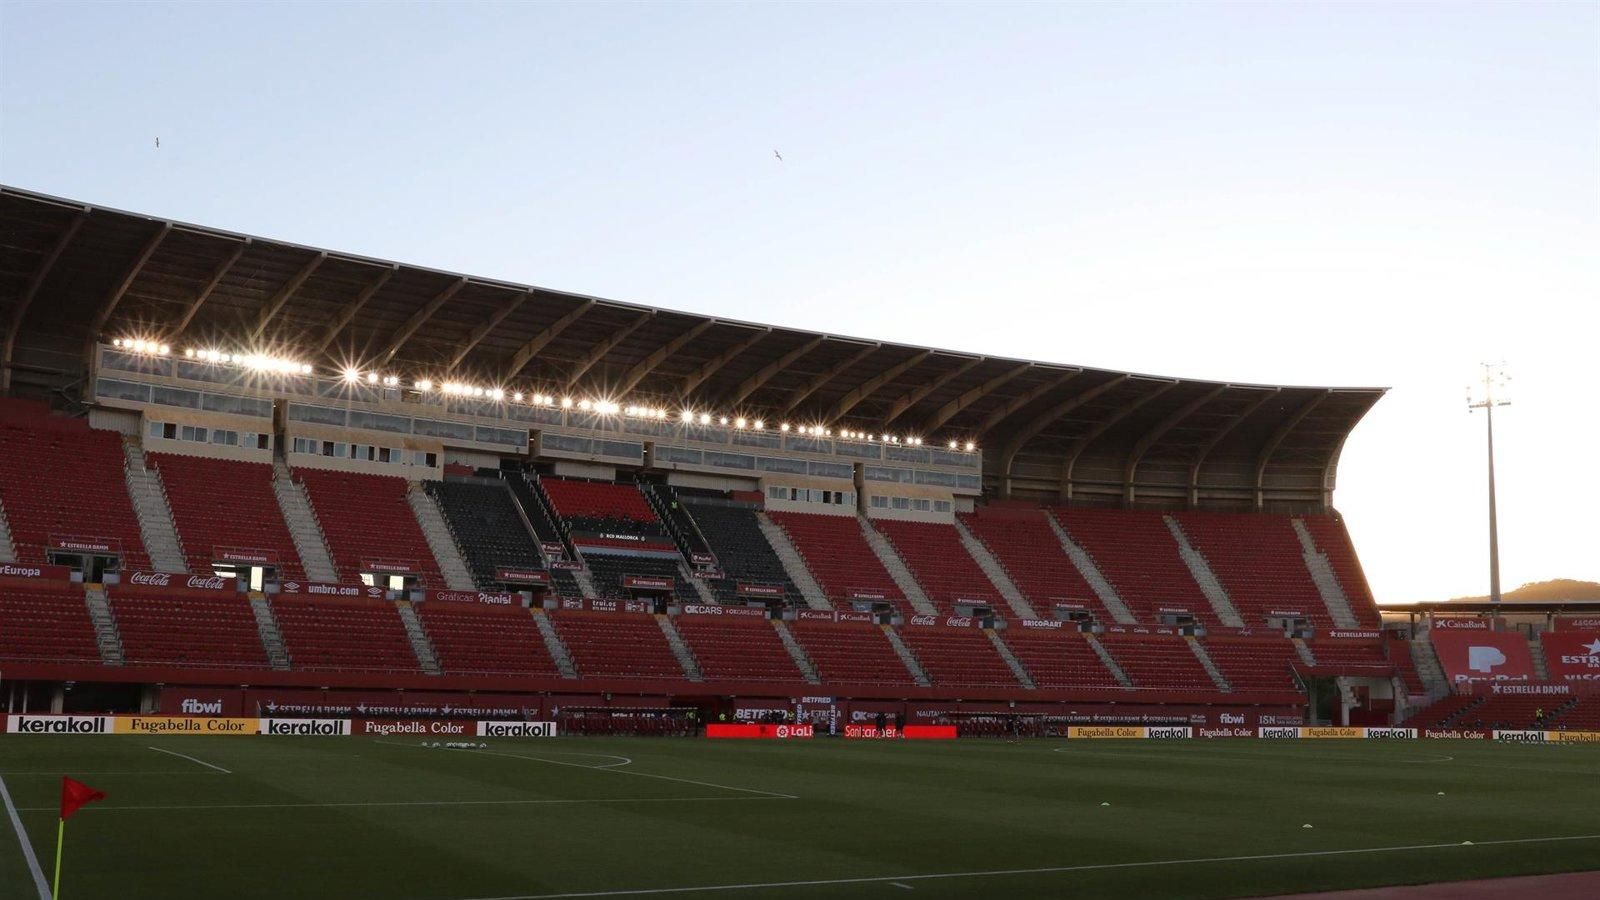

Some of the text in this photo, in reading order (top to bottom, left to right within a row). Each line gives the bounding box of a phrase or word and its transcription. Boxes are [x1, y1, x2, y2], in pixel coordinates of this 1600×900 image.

[308, 584, 359, 596] umbro.com
[1446, 620, 1487, 628] CaixaBank
[1503, 685, 1569, 695] ESTRELLA DAMM
[802, 696, 831, 704] BETFRED
[181, 698, 222, 714] fibwi
[1220, 713, 1245, 724] fibwi
[1259, 715, 1276, 725] ISN
[17, 716, 106, 733] kerakoll
[131, 718, 245, 733] Fugabella Color
[268, 719, 344, 735] kerakoll
[365, 721, 464, 735] Fugabella Color
[485, 722, 551, 736] kerakoll
[1077, 727, 1137, 737] Fugabella Color
[1149, 727, 1188, 738] kerakoll
[1199, 728, 1253, 738] Fugabella Color
[1263, 727, 1299, 738] kerakoll
[1308, 728, 1356, 737] Fugabella Color
[1367, 728, 1412, 738] kerakoll
[1425, 729, 1485, 739] Fugabella Color
[1498, 730, 1544, 740] kerakoll
